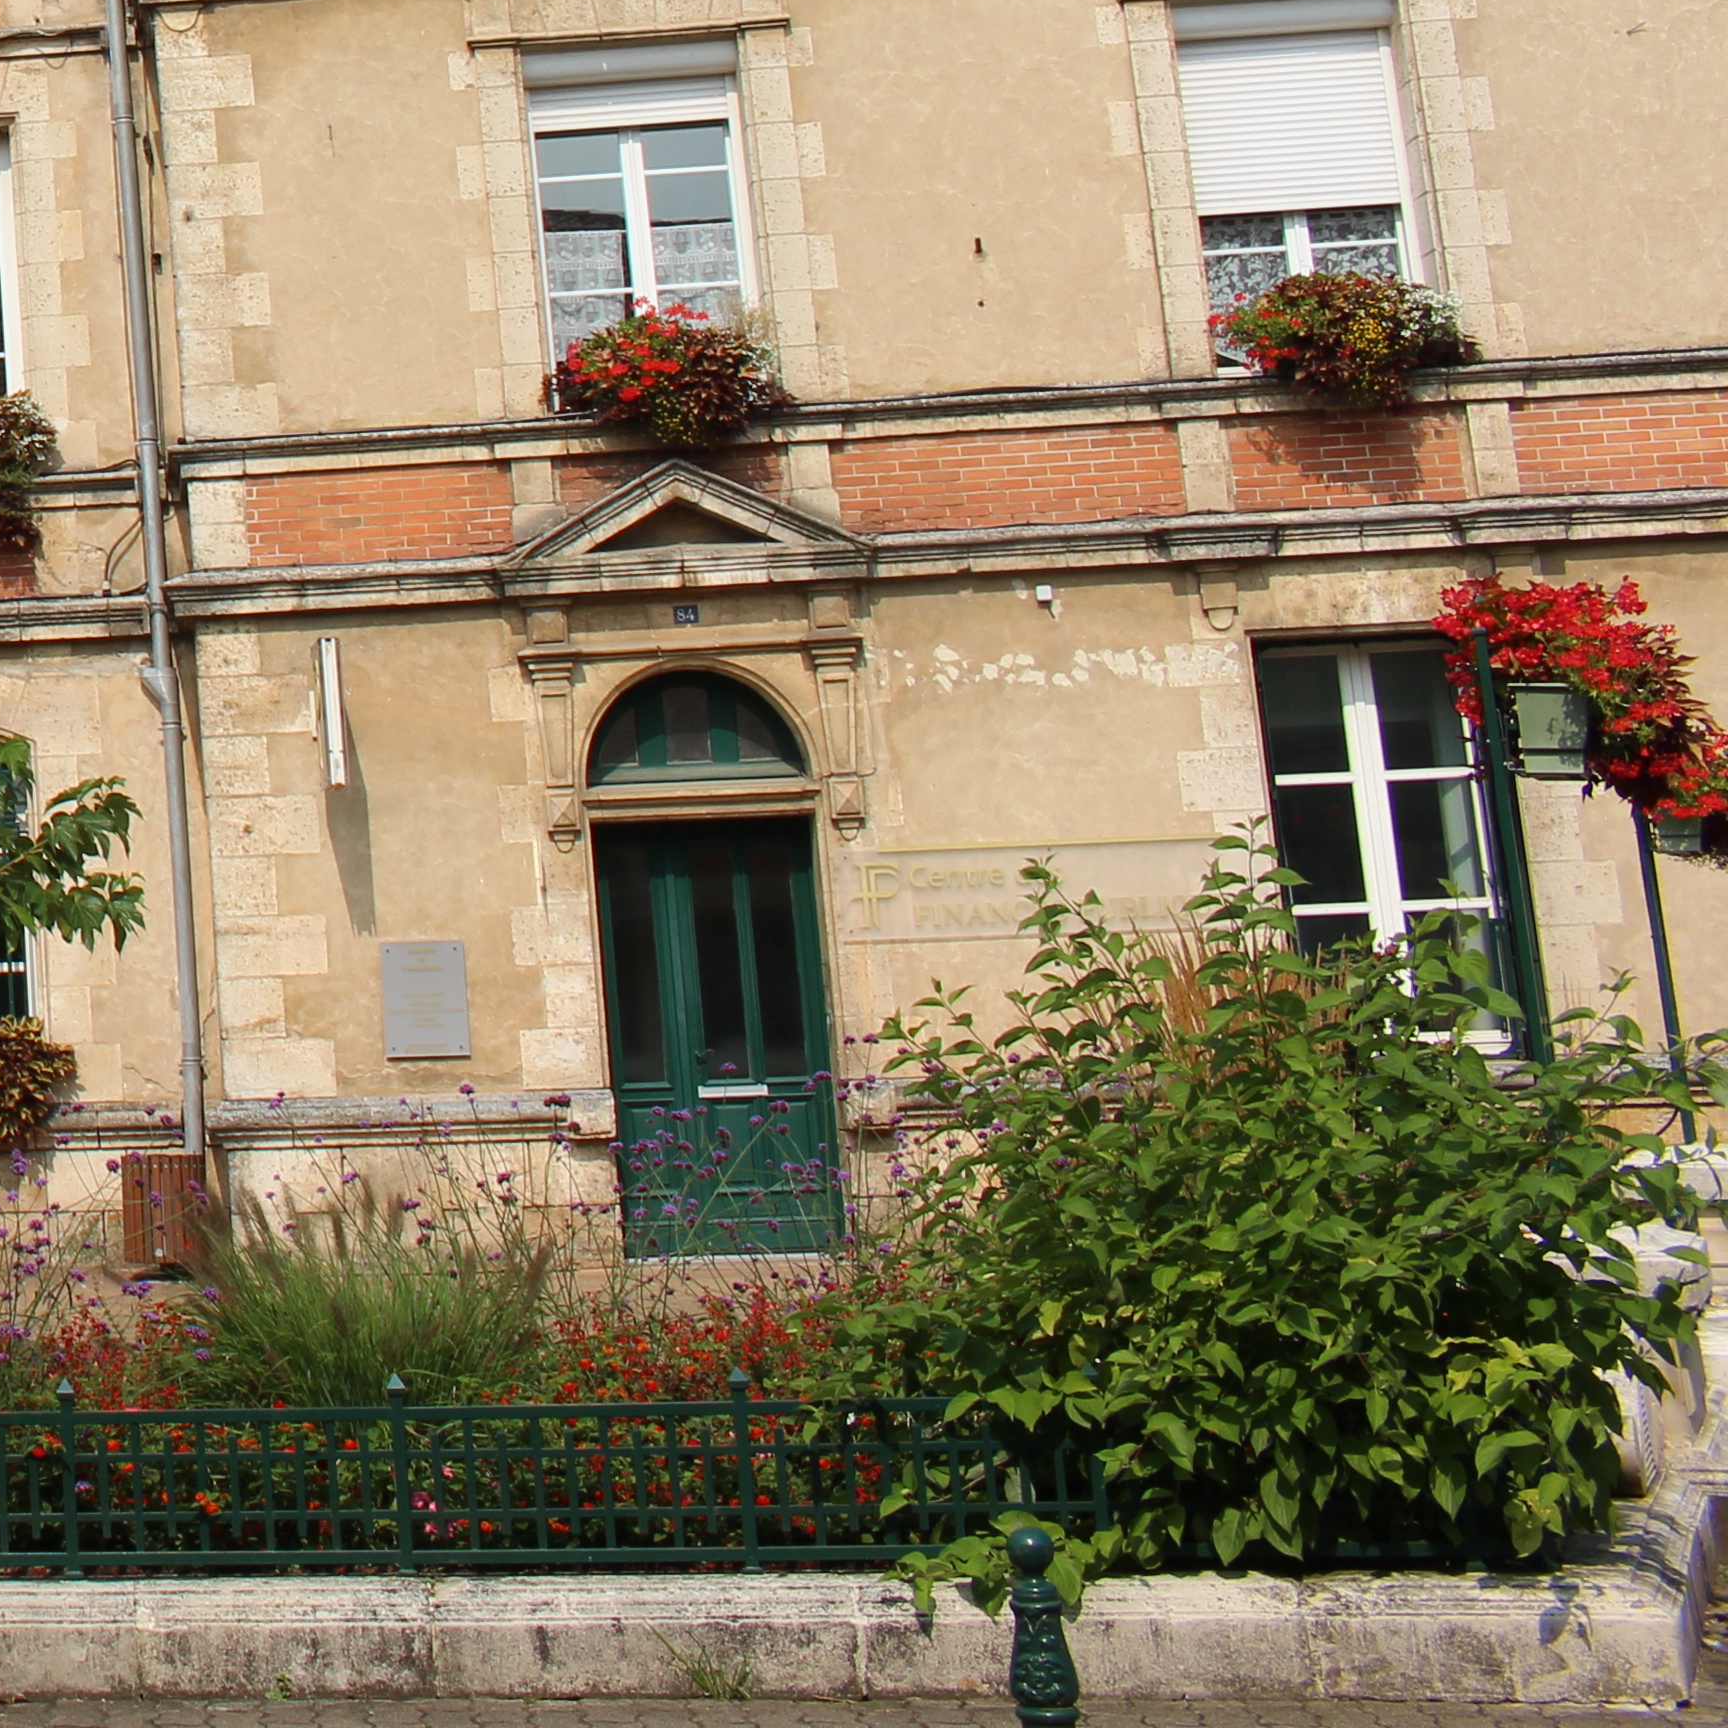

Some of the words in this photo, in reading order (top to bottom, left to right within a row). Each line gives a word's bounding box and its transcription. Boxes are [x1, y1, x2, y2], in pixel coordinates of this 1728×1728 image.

[676, 608, 695, 621] 84
[909, 865, 1005, 889] Centre
[913, 898, 1066, 928] FINANC
